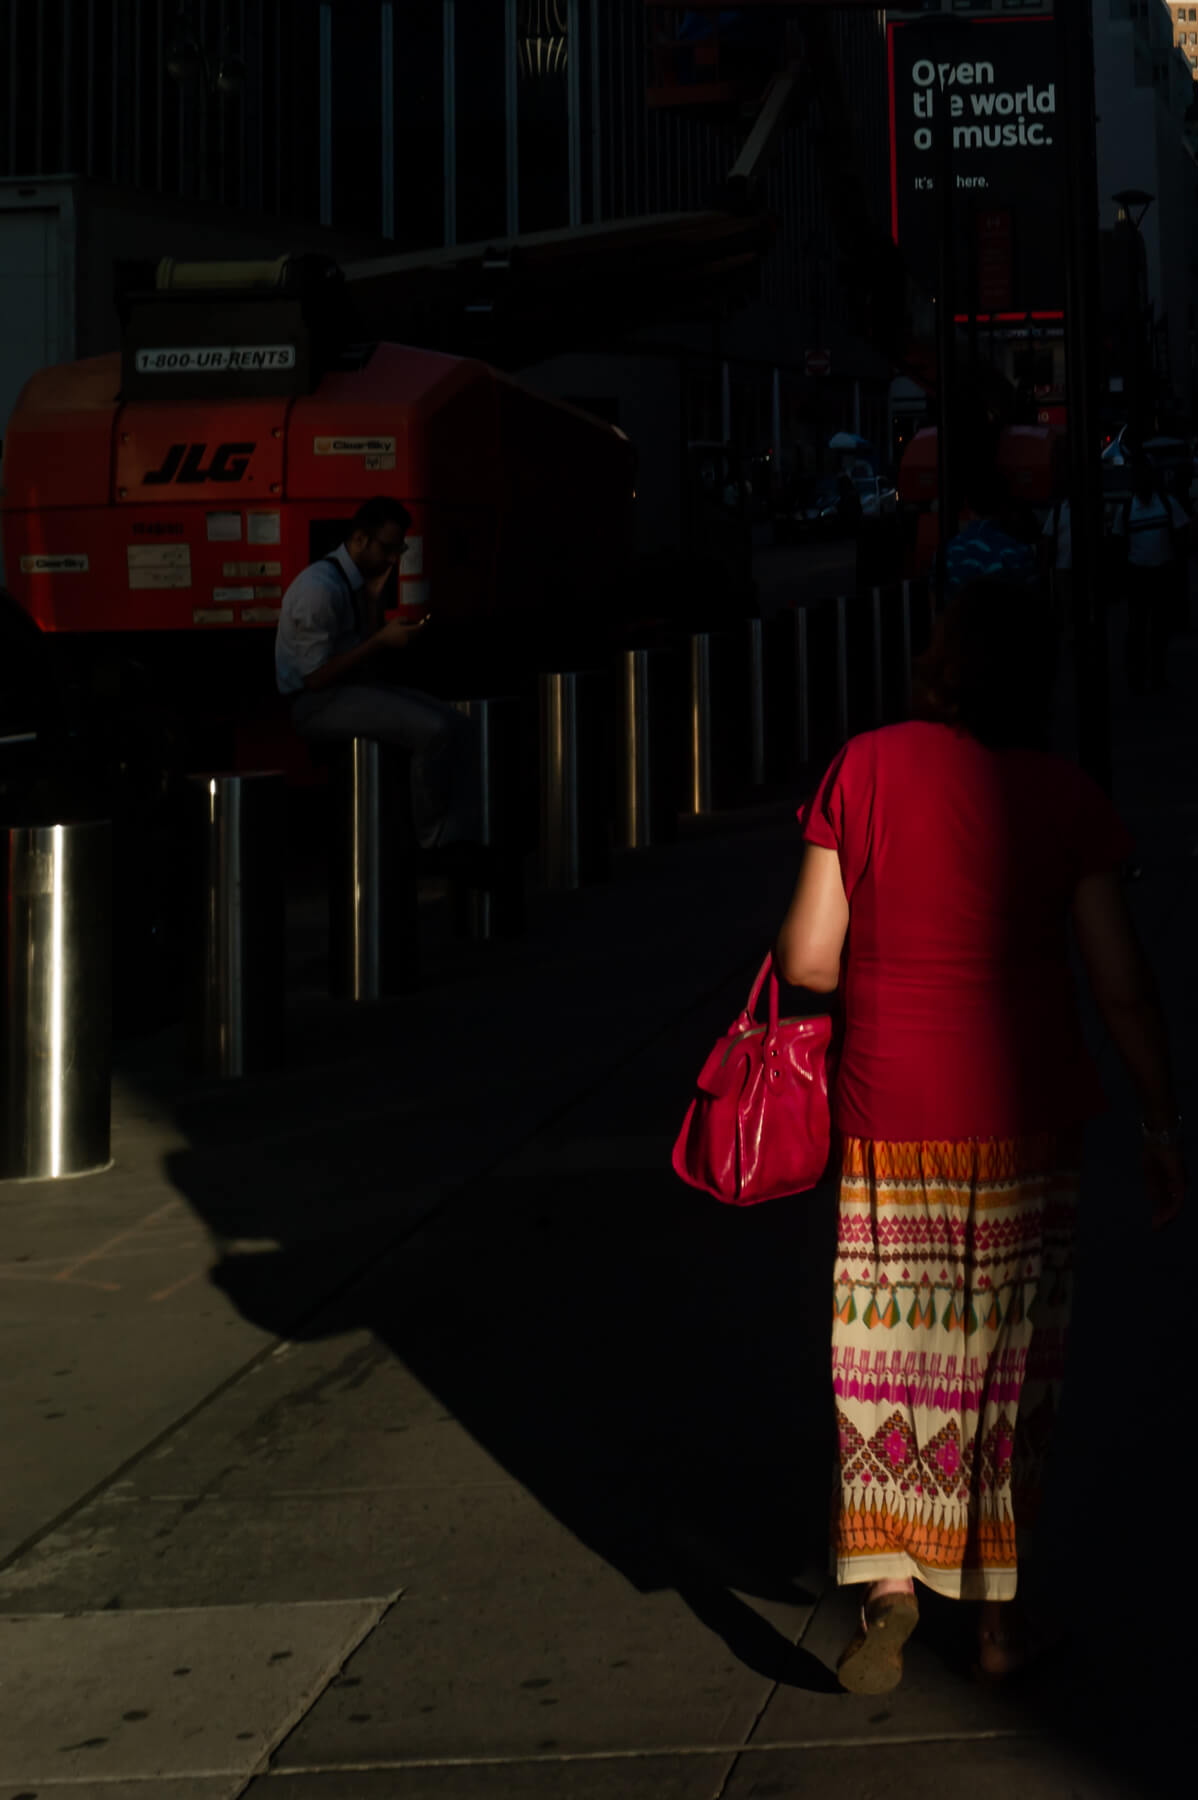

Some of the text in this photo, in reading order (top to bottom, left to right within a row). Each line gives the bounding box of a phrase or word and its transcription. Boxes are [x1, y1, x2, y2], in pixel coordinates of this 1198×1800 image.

[912, 58, 995, 93] Open
[970, 82, 1056, 117] world
[952, 115, 1054, 150] music.
[914, 173, 989, 191] It's here.
[141, 350, 290, 369] 1-800-UR-RENTS
[142, 442, 257, 485] JLG
